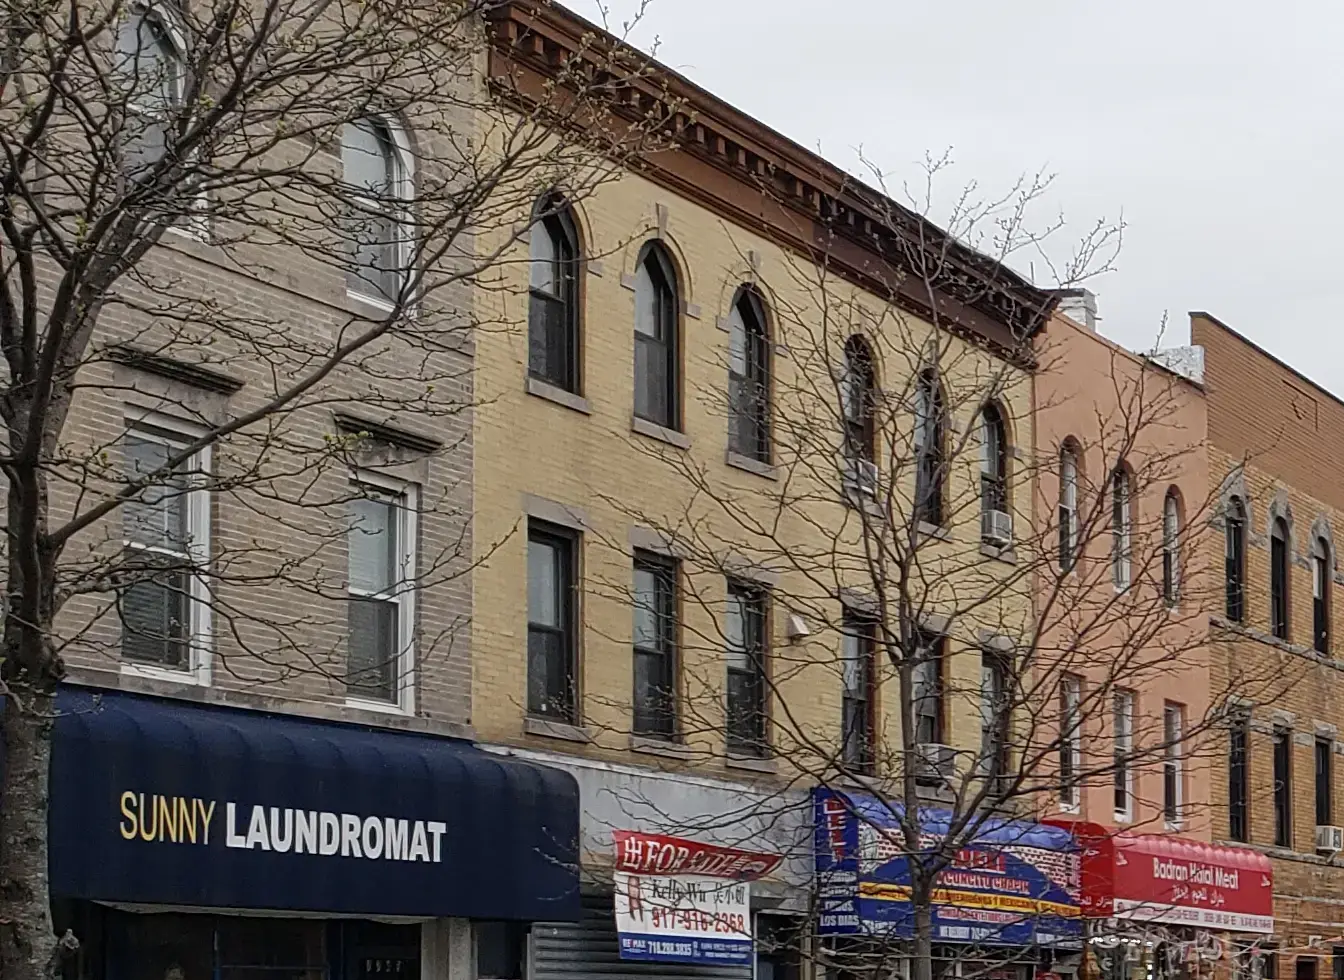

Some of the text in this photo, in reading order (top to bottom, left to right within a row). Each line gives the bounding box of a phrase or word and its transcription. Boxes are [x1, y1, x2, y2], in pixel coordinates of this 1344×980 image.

[120, 791, 447, 863] SUNNY LAUNDROMAT
[644, 841, 688, 874] FOR
[1153, 857, 1239, 890] Badran Halal Meat
